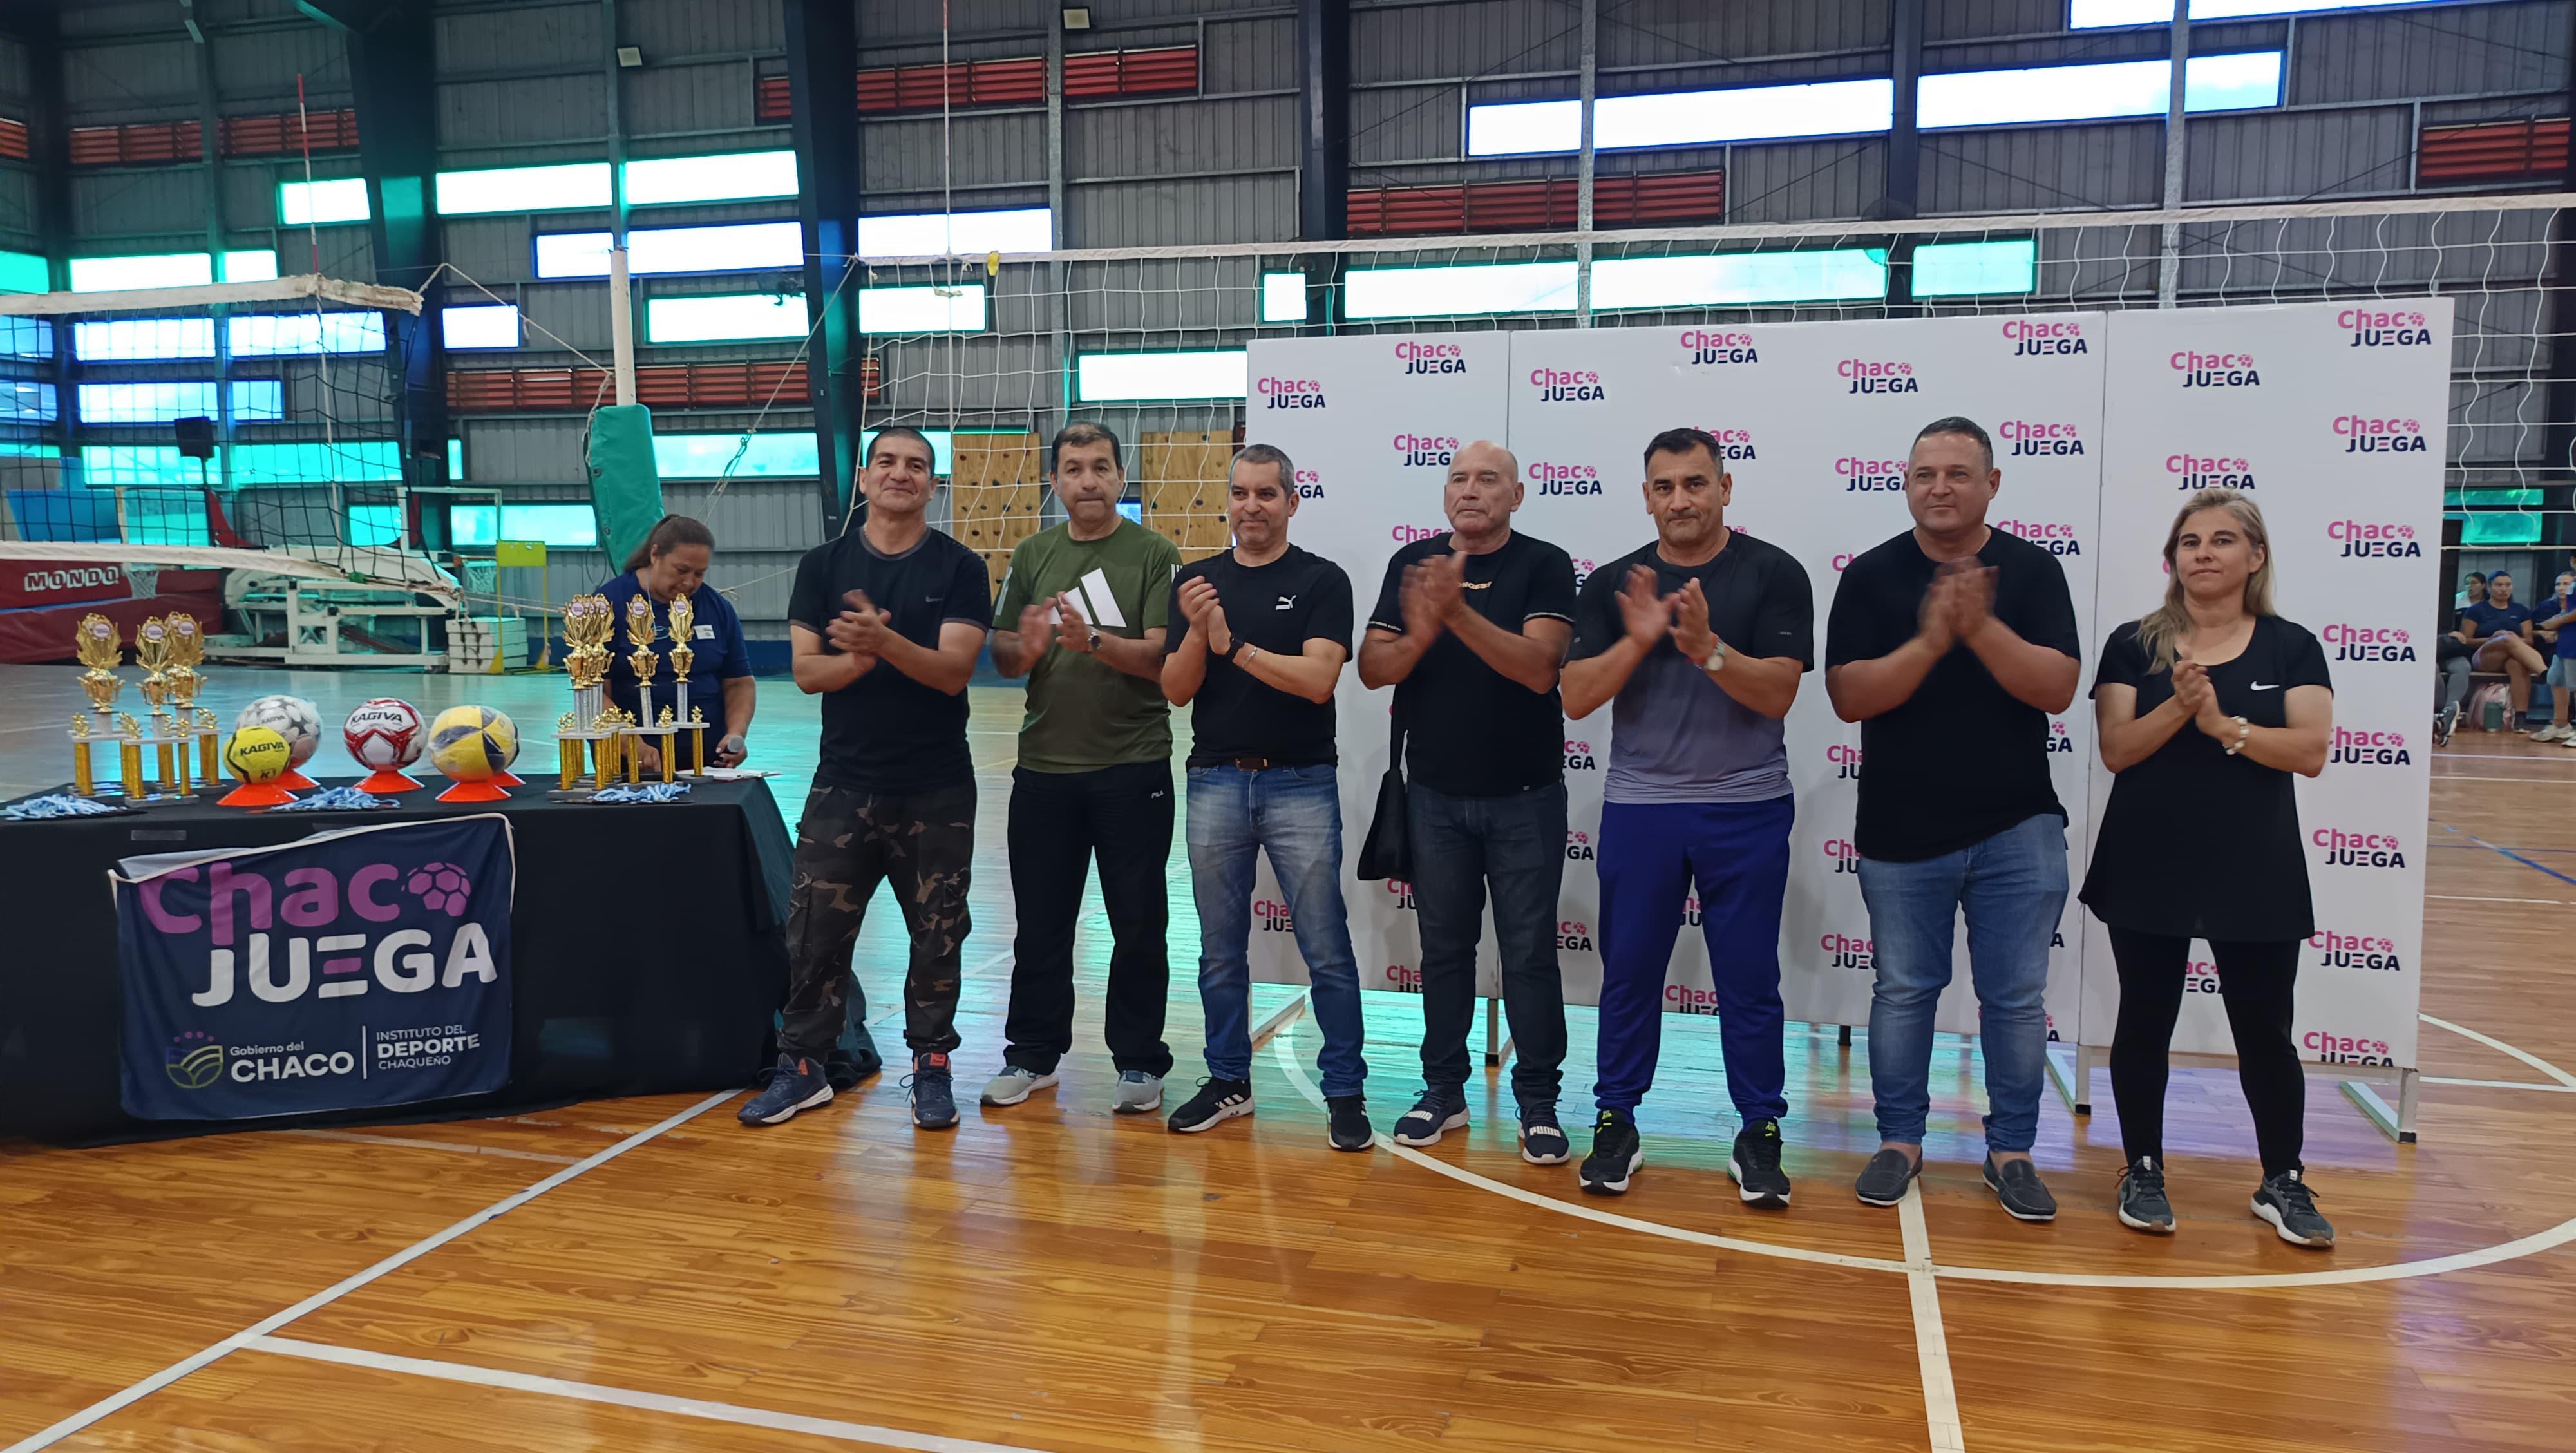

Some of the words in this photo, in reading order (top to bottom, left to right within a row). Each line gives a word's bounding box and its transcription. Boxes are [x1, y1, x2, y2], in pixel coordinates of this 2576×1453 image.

[2351, 329, 2431, 347] JUEGA
[1692, 348, 1757, 364] JUEGA
[2014, 339, 2087, 356] JUEGA
[1405, 359, 1466, 374] JUEGA
[1849, 377, 1918, 394] JUEGA
[2183, 370, 2260, 387] JUEGA
[1267, 394, 1325, 409] JUEGA
[1541, 386, 1604, 401] JUEGA
[2012, 439, 2084, 455] JUEGA
[2345, 435, 2426, 452] JUEGA
[1404, 451, 1450, 466] JUEG
[1539, 480, 1602, 495] JUEGA
[1846, 475, 1905, 491] JUEG
[2179, 473, 2255, 490] JUEGA
[2341, 540, 2421, 557] JUEGA
[24, 566, 120, 591] MONDO
[2336, 644, 2416, 661] JUEGA
[350, 712, 402, 725] KAGIVA
[240, 741, 285, 756] KAGIVA
[2330, 746, 2410, 765] JUEGA
[2325, 848, 2405, 868] JUEGA
[1557, 937, 1592, 951] EGA
[191, 923, 498, 1007] JUEGA
[2321, 951, 2400, 971] JUEGA
[376, 1026, 442, 1041] INSTITUTO
[444, 1024, 466, 1036] DEL
[230, 1044, 285, 1056] Gobierno
[287, 1041, 305, 1052] del
[377, 1033, 480, 1058] DEPORTE
[231, 1051, 355, 1083] CHACO
[378, 1055, 451, 1070] CHAQUEÑO
[1530, 1125, 1561, 1137] PUMA
